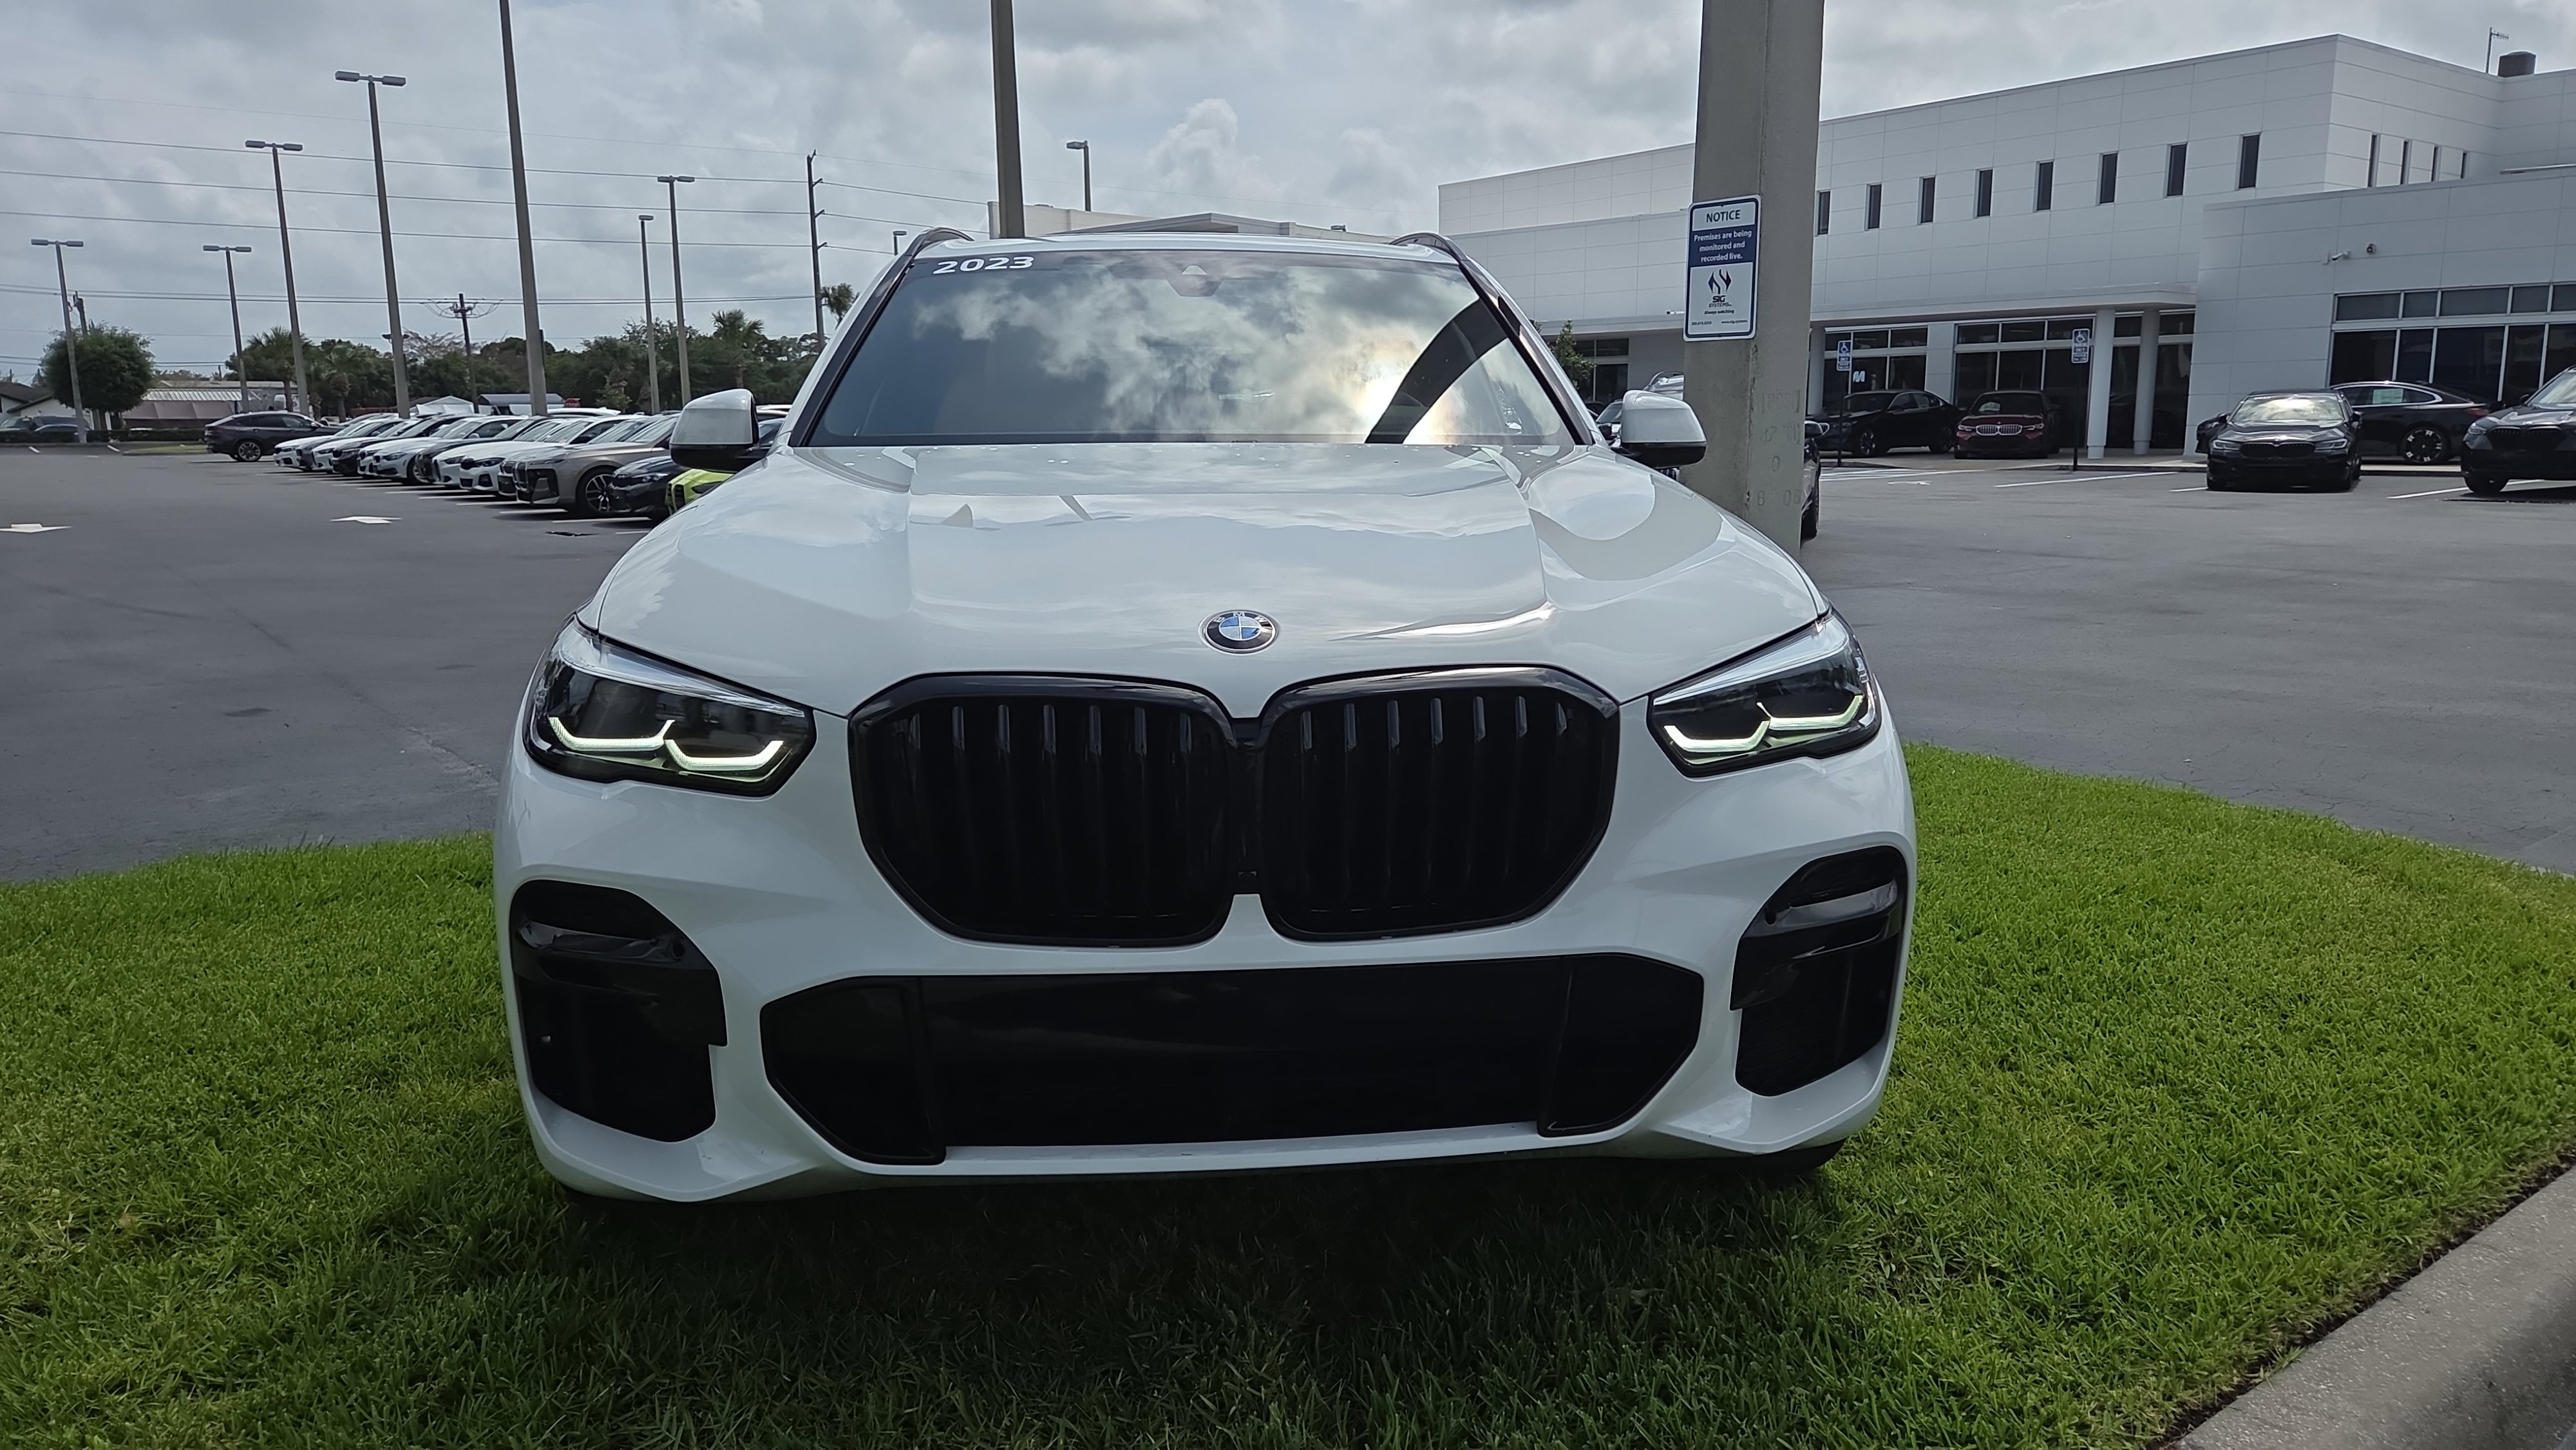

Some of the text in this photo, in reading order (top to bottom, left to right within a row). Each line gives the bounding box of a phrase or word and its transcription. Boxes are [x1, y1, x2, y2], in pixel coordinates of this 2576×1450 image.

[1706, 210, 1741, 223] NOTICE
[1694, 233, 1721, 242] Premises
[1733, 230, 1752, 238] being
[1700, 242, 1732, 252] monitored
[1701, 252, 1743, 263] recorded live.
[933, 256, 1034, 274] 2023
[1213, 612, 1267, 623] BMW
